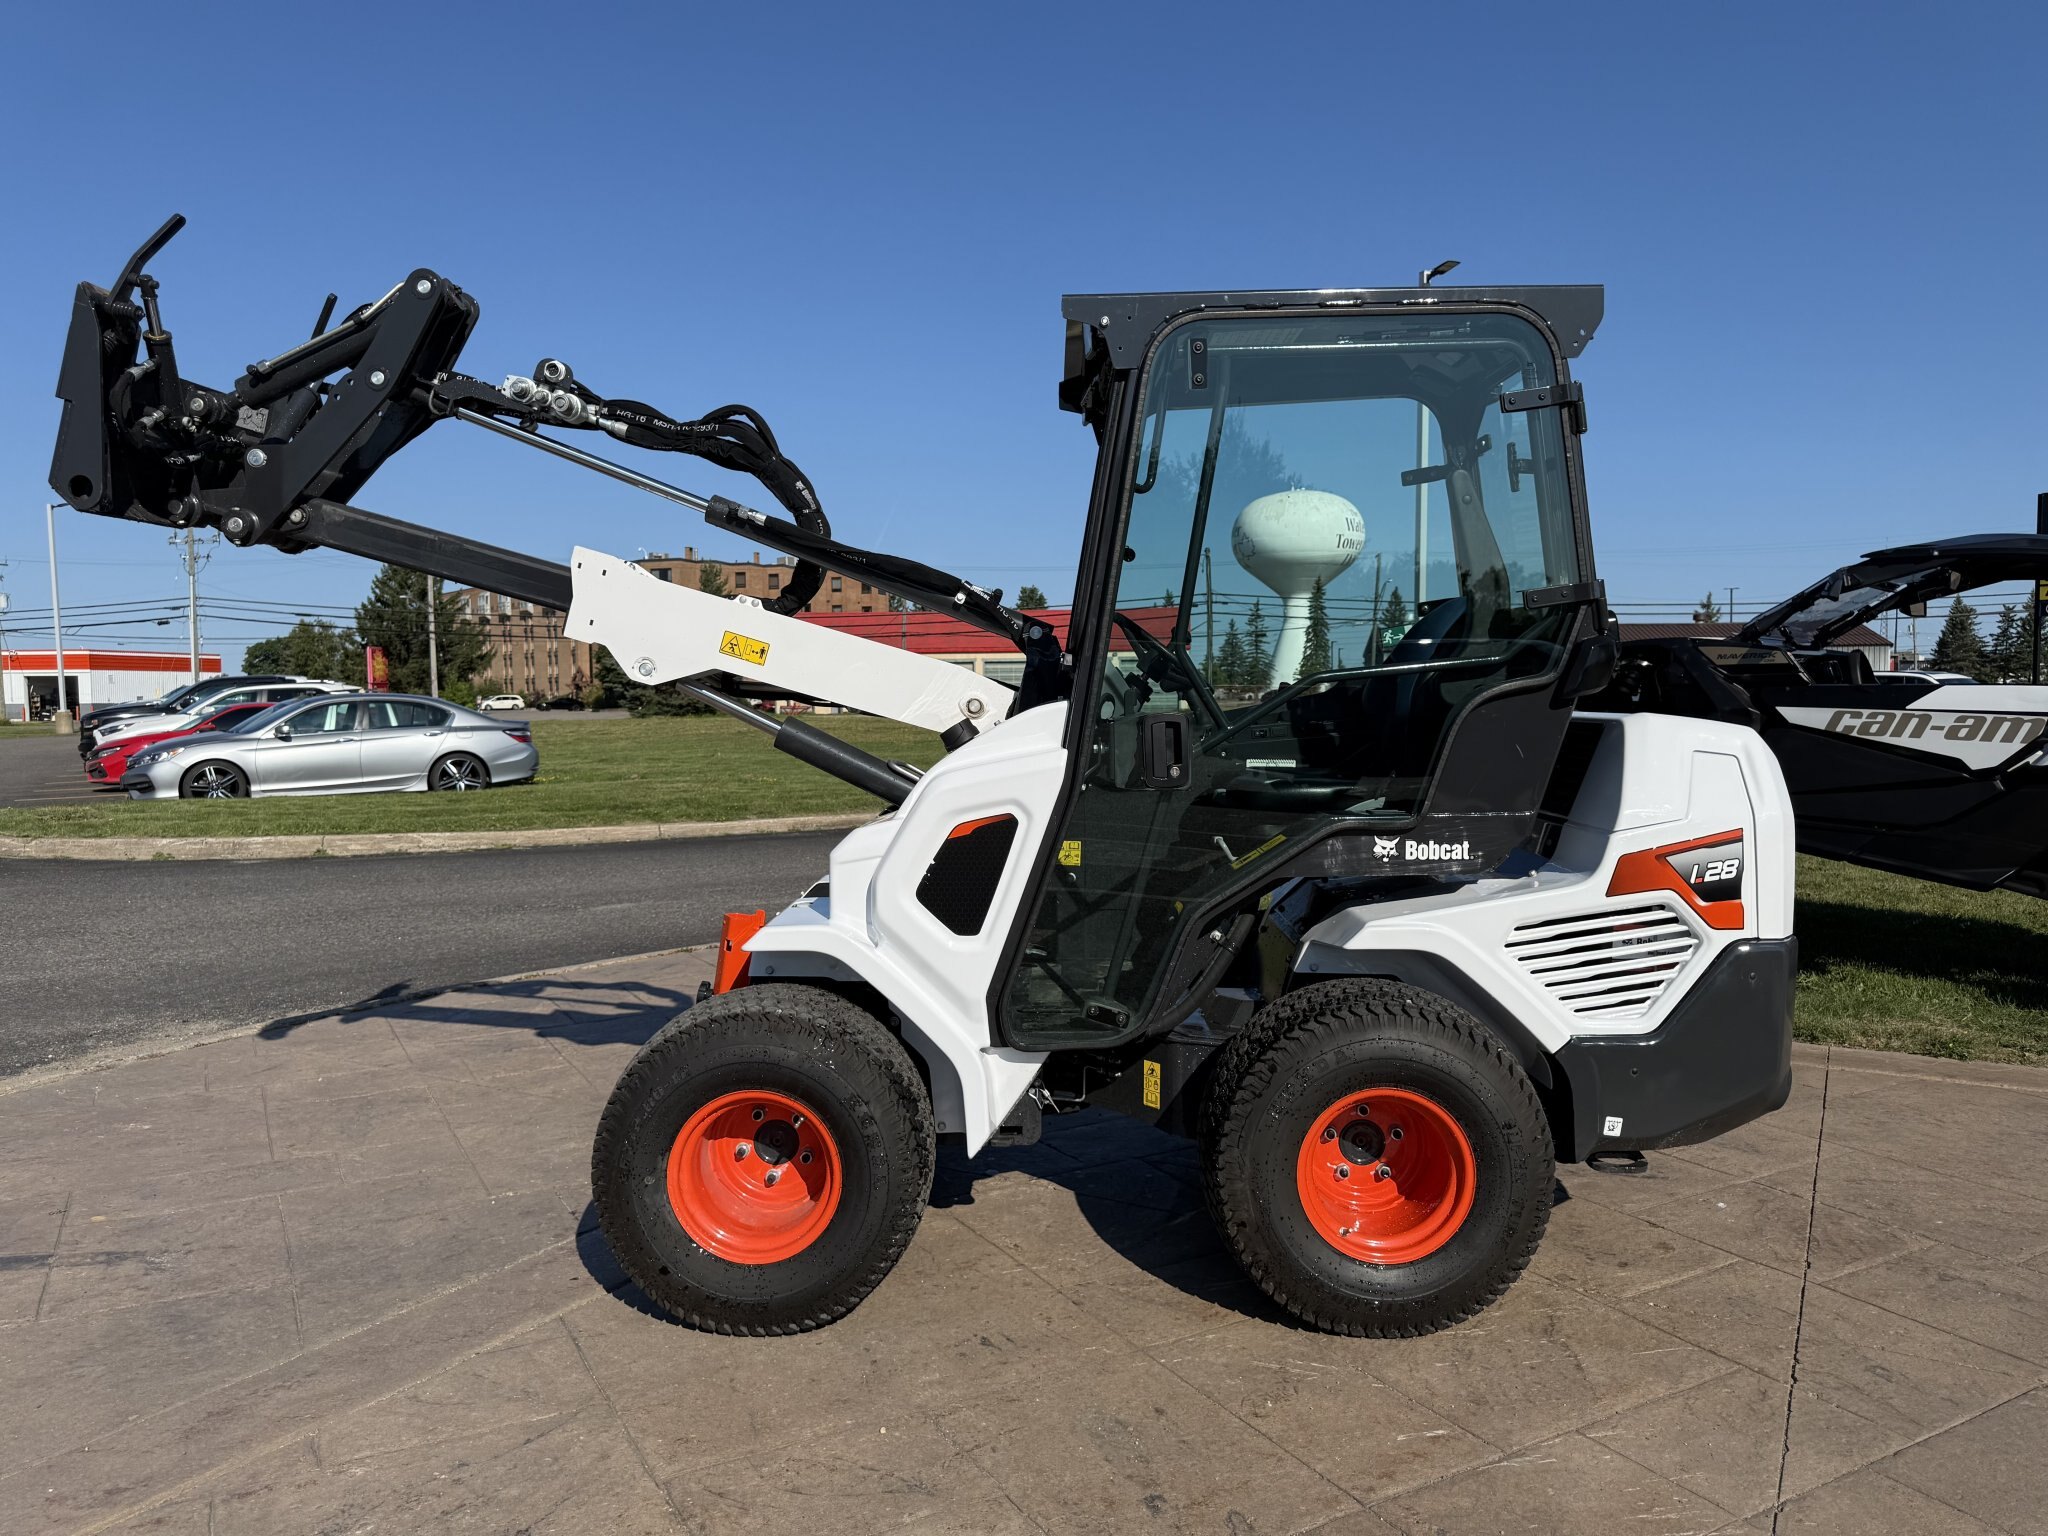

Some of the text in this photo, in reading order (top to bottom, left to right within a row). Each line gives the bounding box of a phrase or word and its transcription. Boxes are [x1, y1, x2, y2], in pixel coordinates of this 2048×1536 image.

[1716, 651, 1777, 660] MAVERICK
[1405, 840, 1471, 860] Bobcat
[1690, 858, 1741, 884] L28
